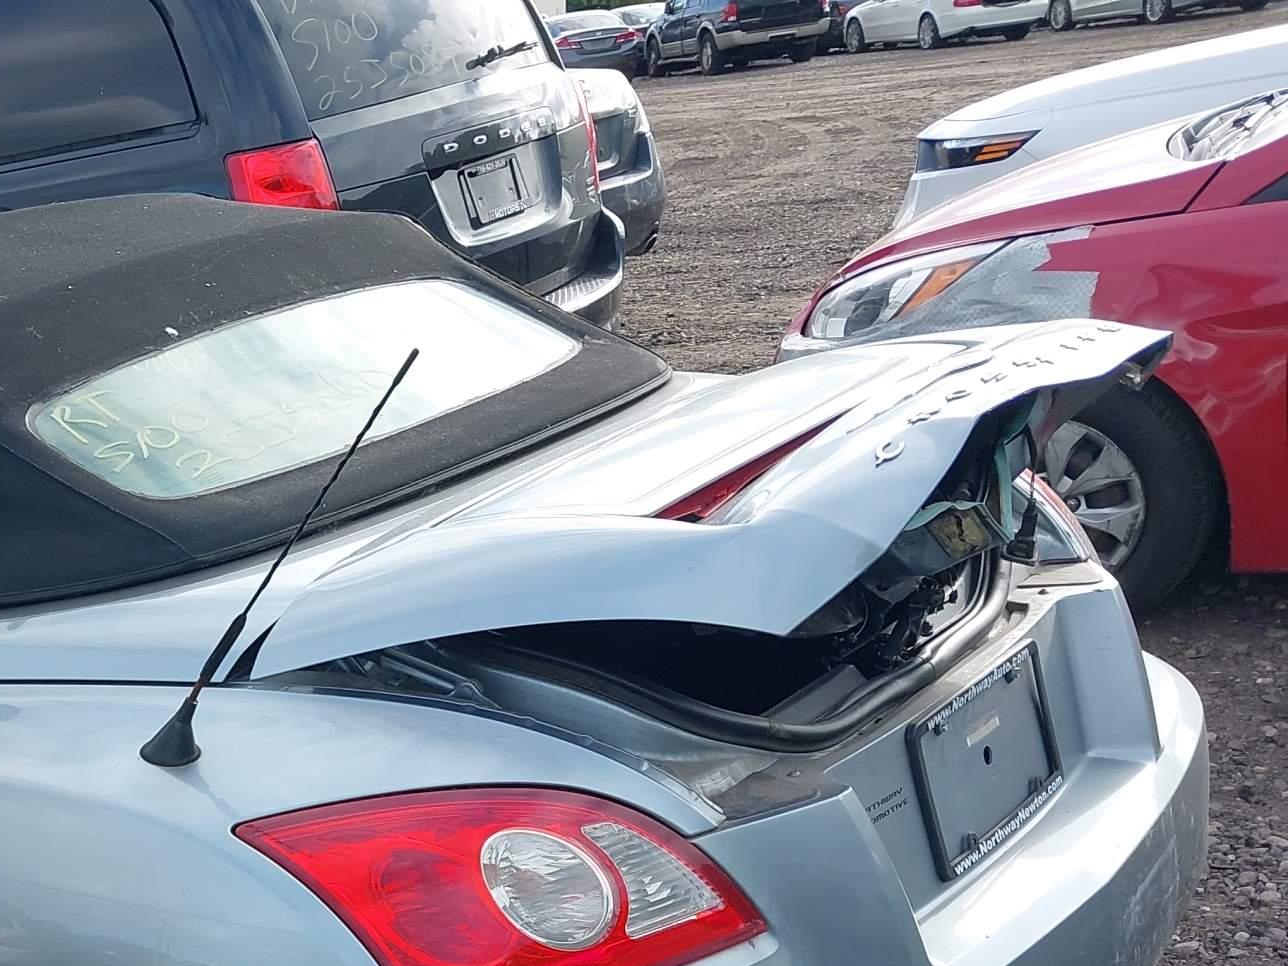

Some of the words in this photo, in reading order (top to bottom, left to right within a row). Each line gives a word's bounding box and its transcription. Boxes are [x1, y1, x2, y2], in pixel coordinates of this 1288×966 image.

[443, 116, 547, 153] DODGE
[50, 391, 120, 445] RT
[94, 412, 209, 473] S100
[927, 647, 1030, 731] www.NorthwayAuto.com
[954, 774, 1063, 876] www.NorthwayNewton.com
